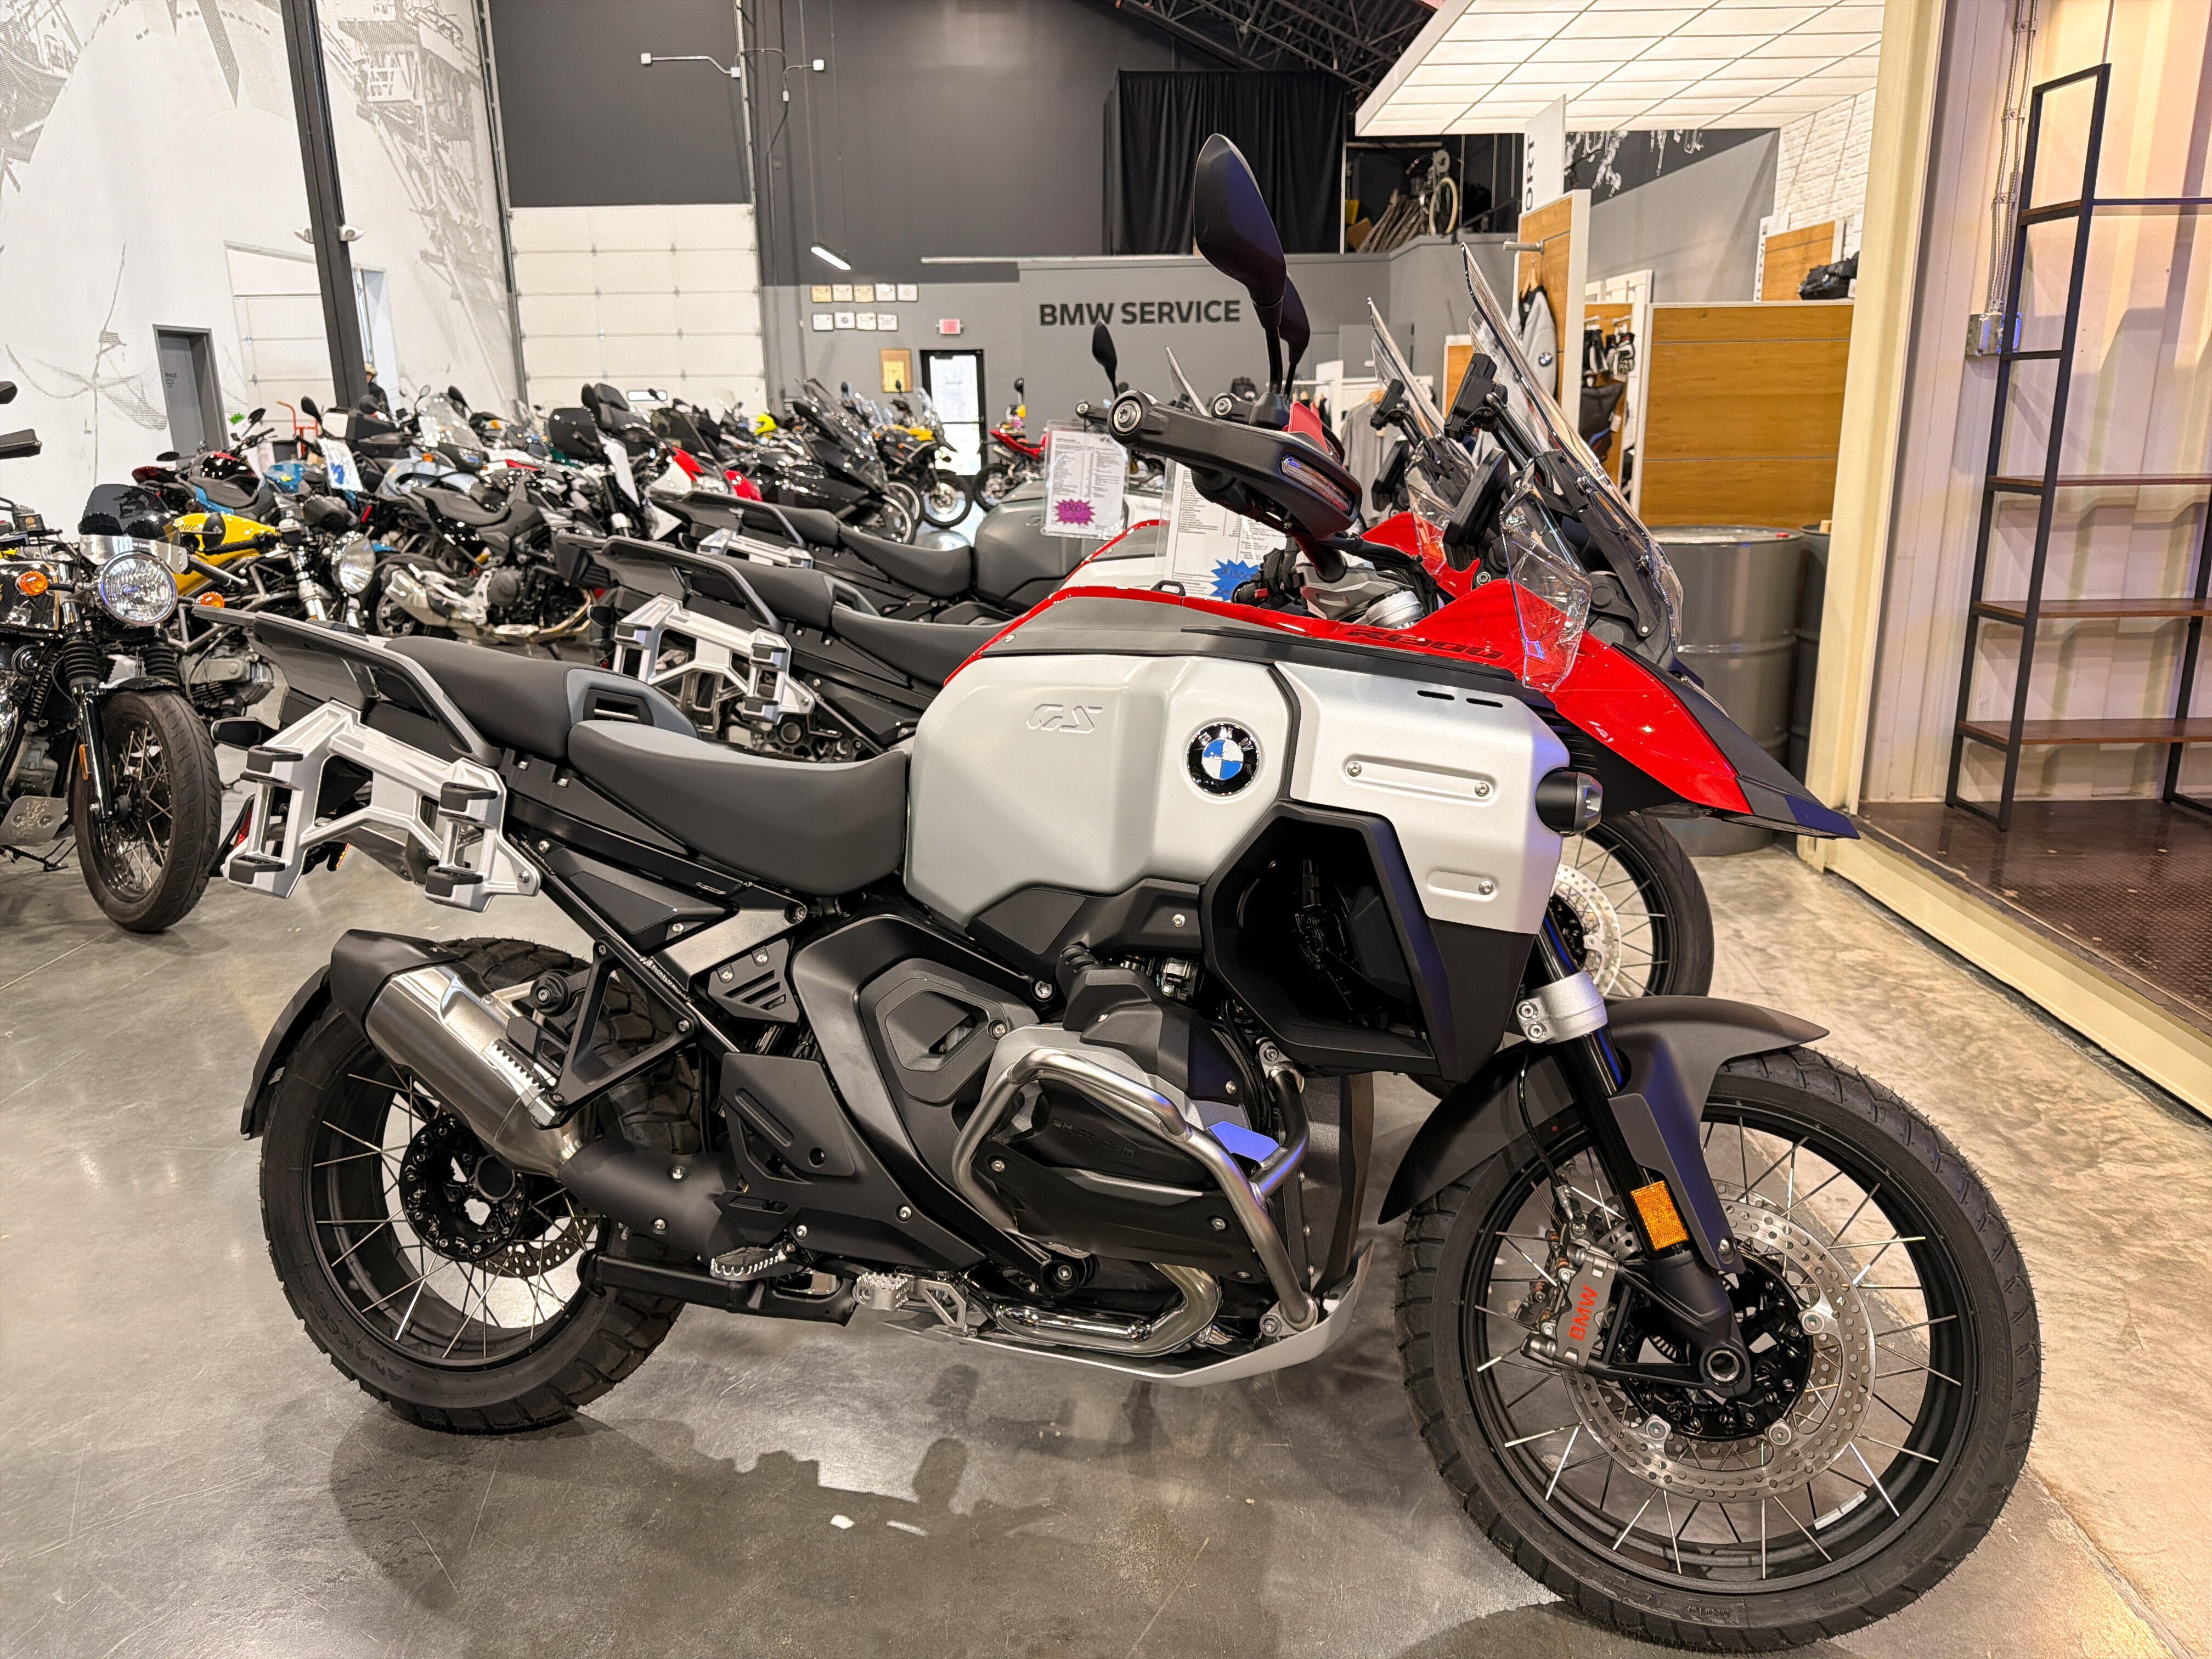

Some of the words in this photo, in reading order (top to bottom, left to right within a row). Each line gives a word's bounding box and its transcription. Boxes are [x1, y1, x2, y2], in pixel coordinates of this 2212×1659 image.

[1040, 302, 1115, 326] BMW
[1121, 300, 1240, 325] SERVICE
[1025, 703, 1103, 734] GS
[1197, 726, 1254, 752] BMW
[1568, 1284, 1598, 1341] BMW
